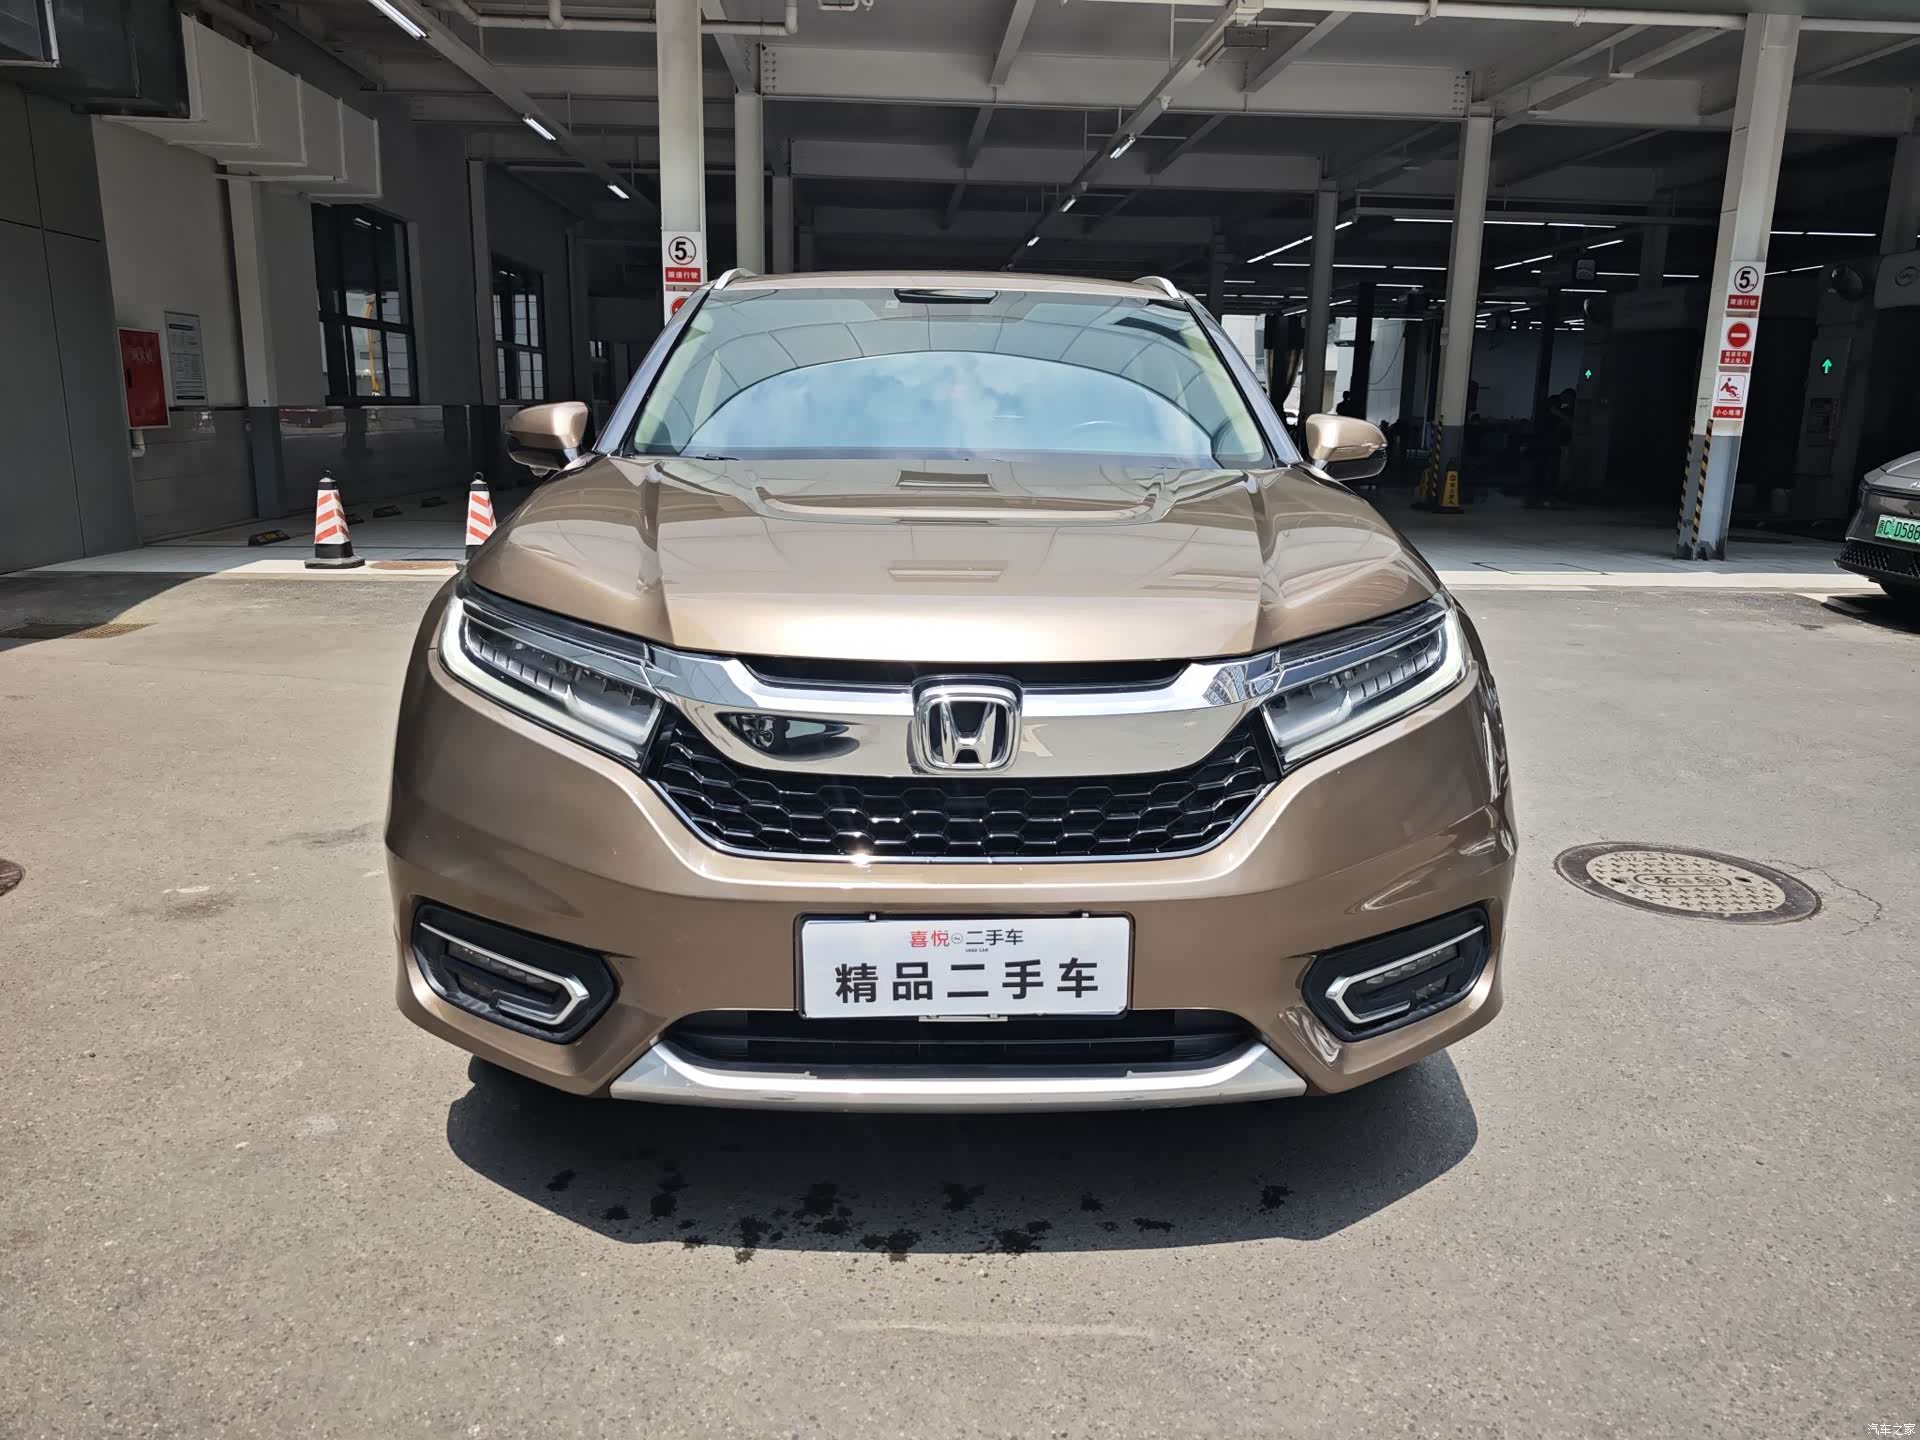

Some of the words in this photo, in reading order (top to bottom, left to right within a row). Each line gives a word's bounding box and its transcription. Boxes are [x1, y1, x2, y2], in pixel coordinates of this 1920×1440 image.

[674, 241, 687, 261] 5
[1738, 270, 1751, 289] 5
[910, 929, 950, 948] 喜悦
[965, 928, 1024, 946] 二手车
[834, 957, 1099, 1004] 精品二手车
